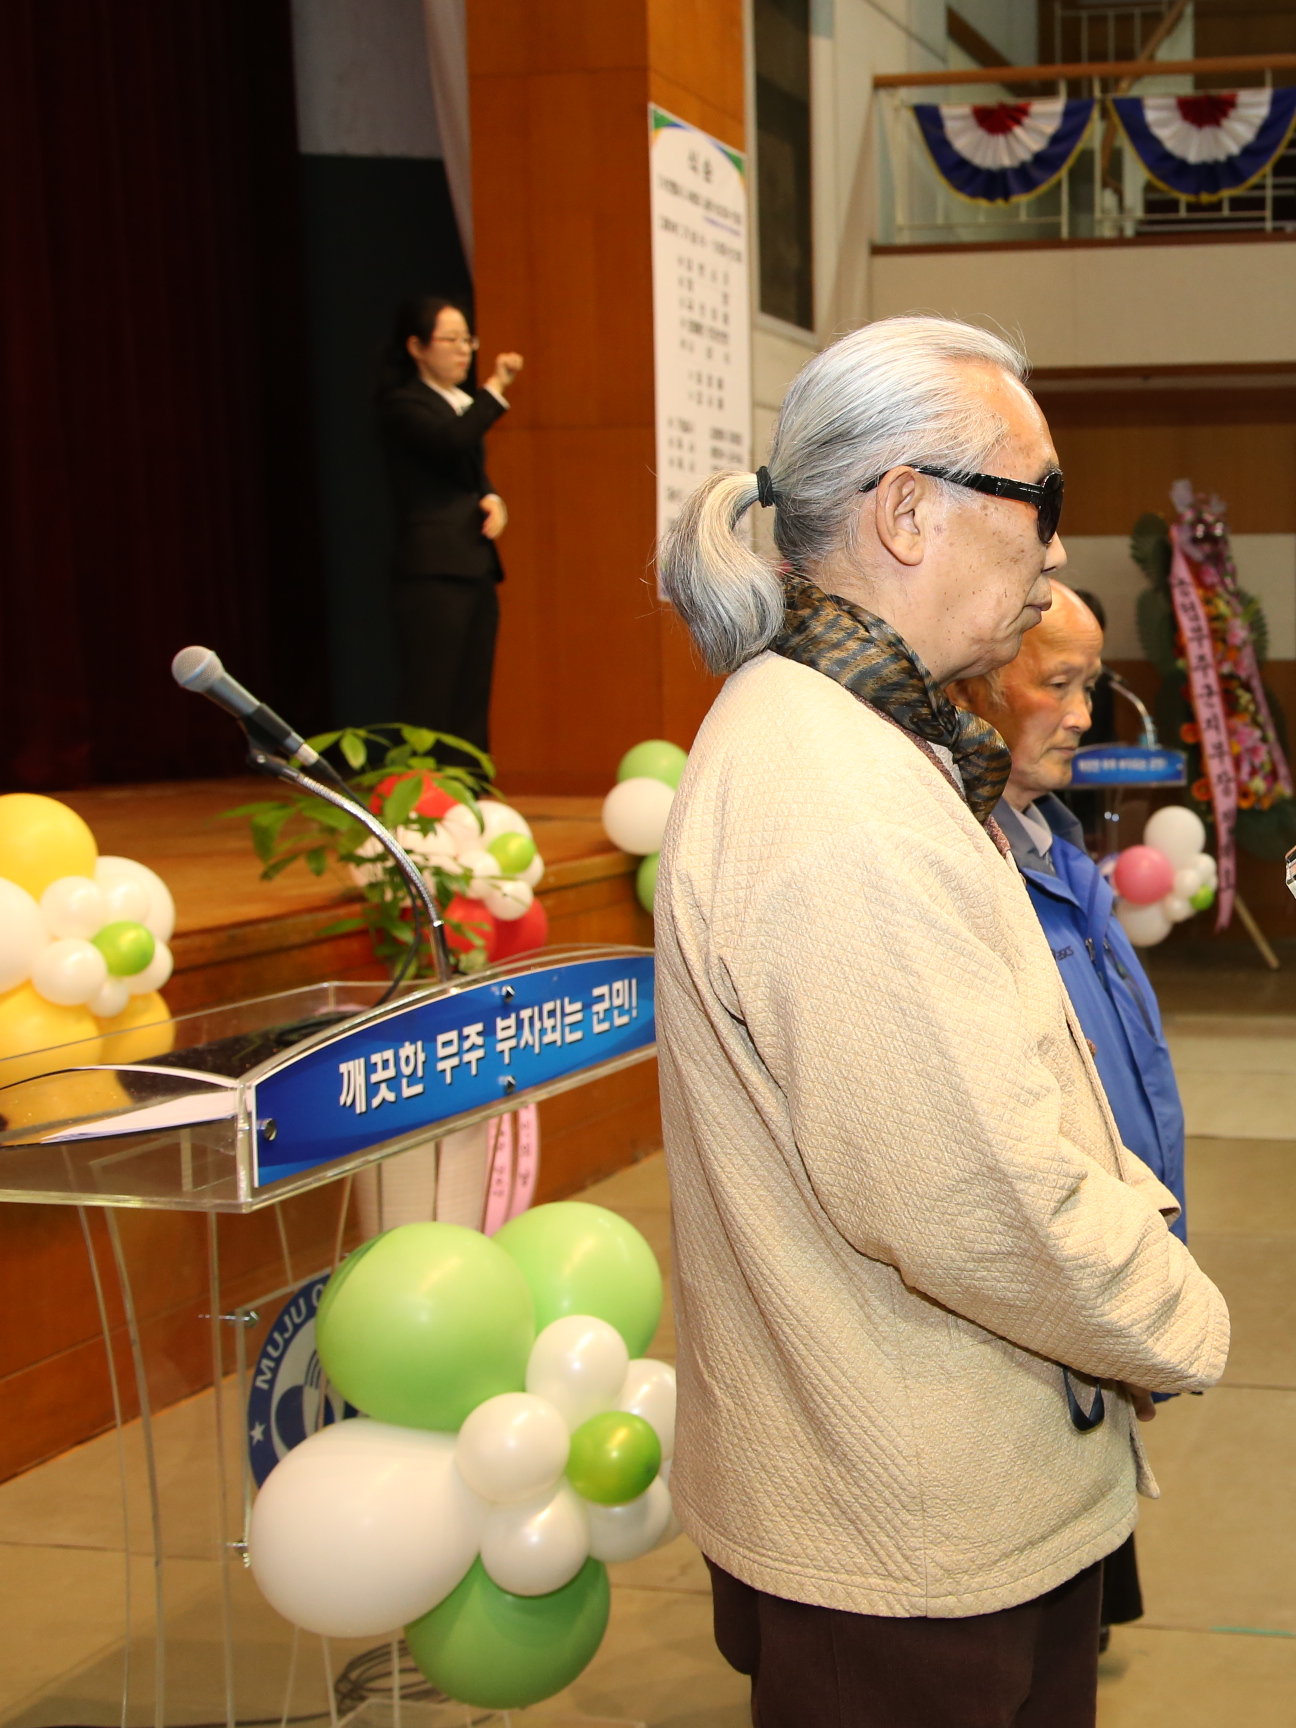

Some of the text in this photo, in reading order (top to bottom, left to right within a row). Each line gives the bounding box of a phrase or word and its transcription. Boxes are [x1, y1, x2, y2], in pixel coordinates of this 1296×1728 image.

[339, 978, 638, 1114] 깨끗한 무주 부자되는 군민!
[255, 1297, 307, 1391] MUJU
